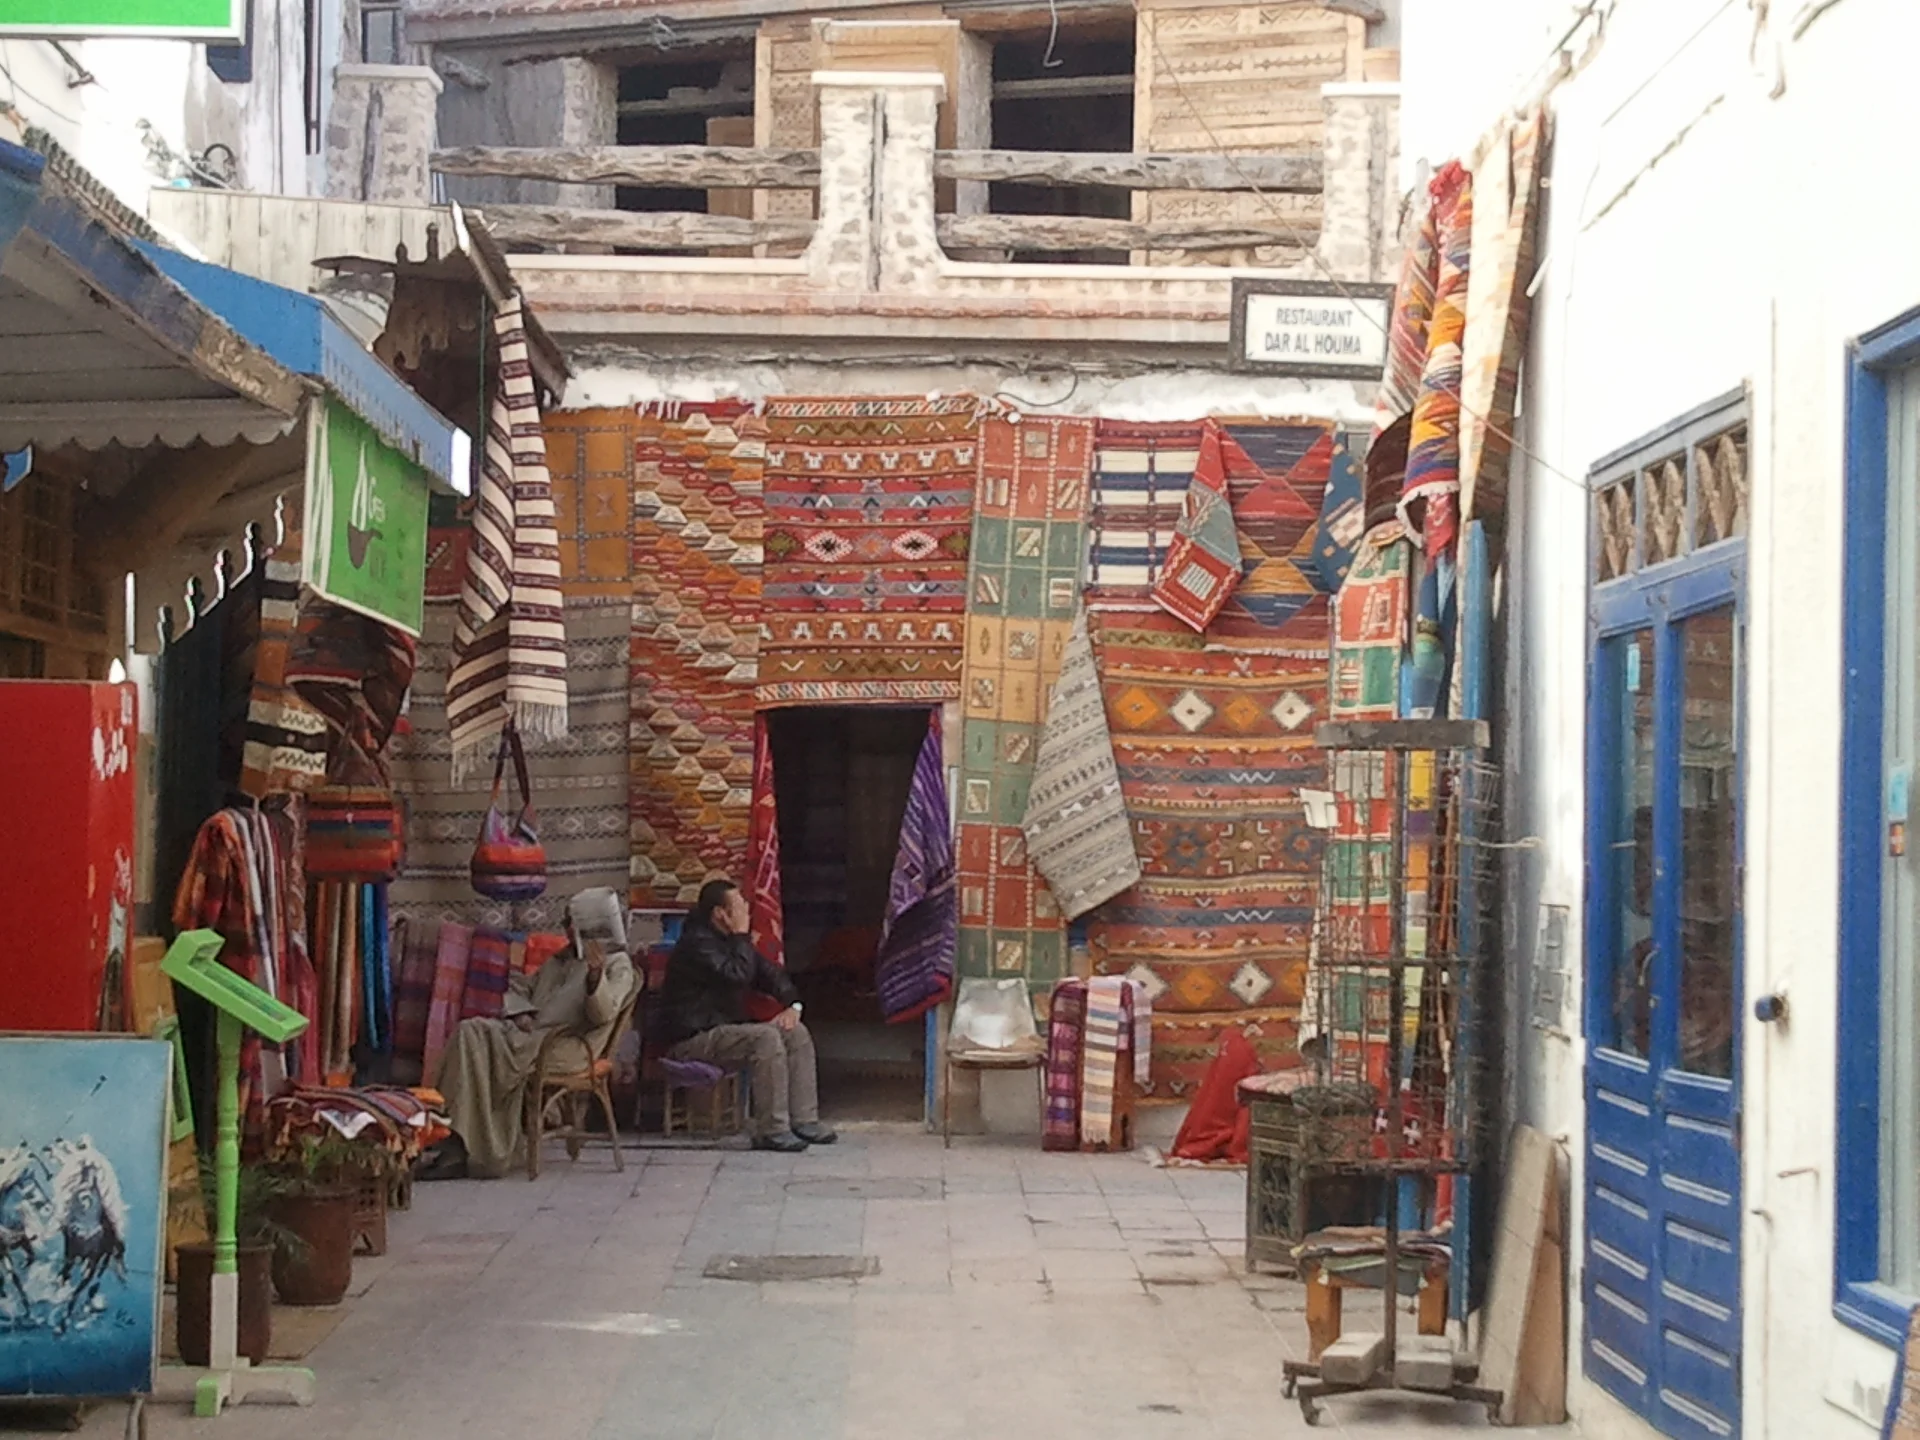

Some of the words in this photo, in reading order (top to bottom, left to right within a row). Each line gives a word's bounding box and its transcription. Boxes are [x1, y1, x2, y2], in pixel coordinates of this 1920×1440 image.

[1276, 307, 1353, 328] RESTAURANT
[1265, 332, 1291, 351] DAR
[1295, 334, 1310, 353] AL
[1314, 334, 1361, 355] HOUMA
